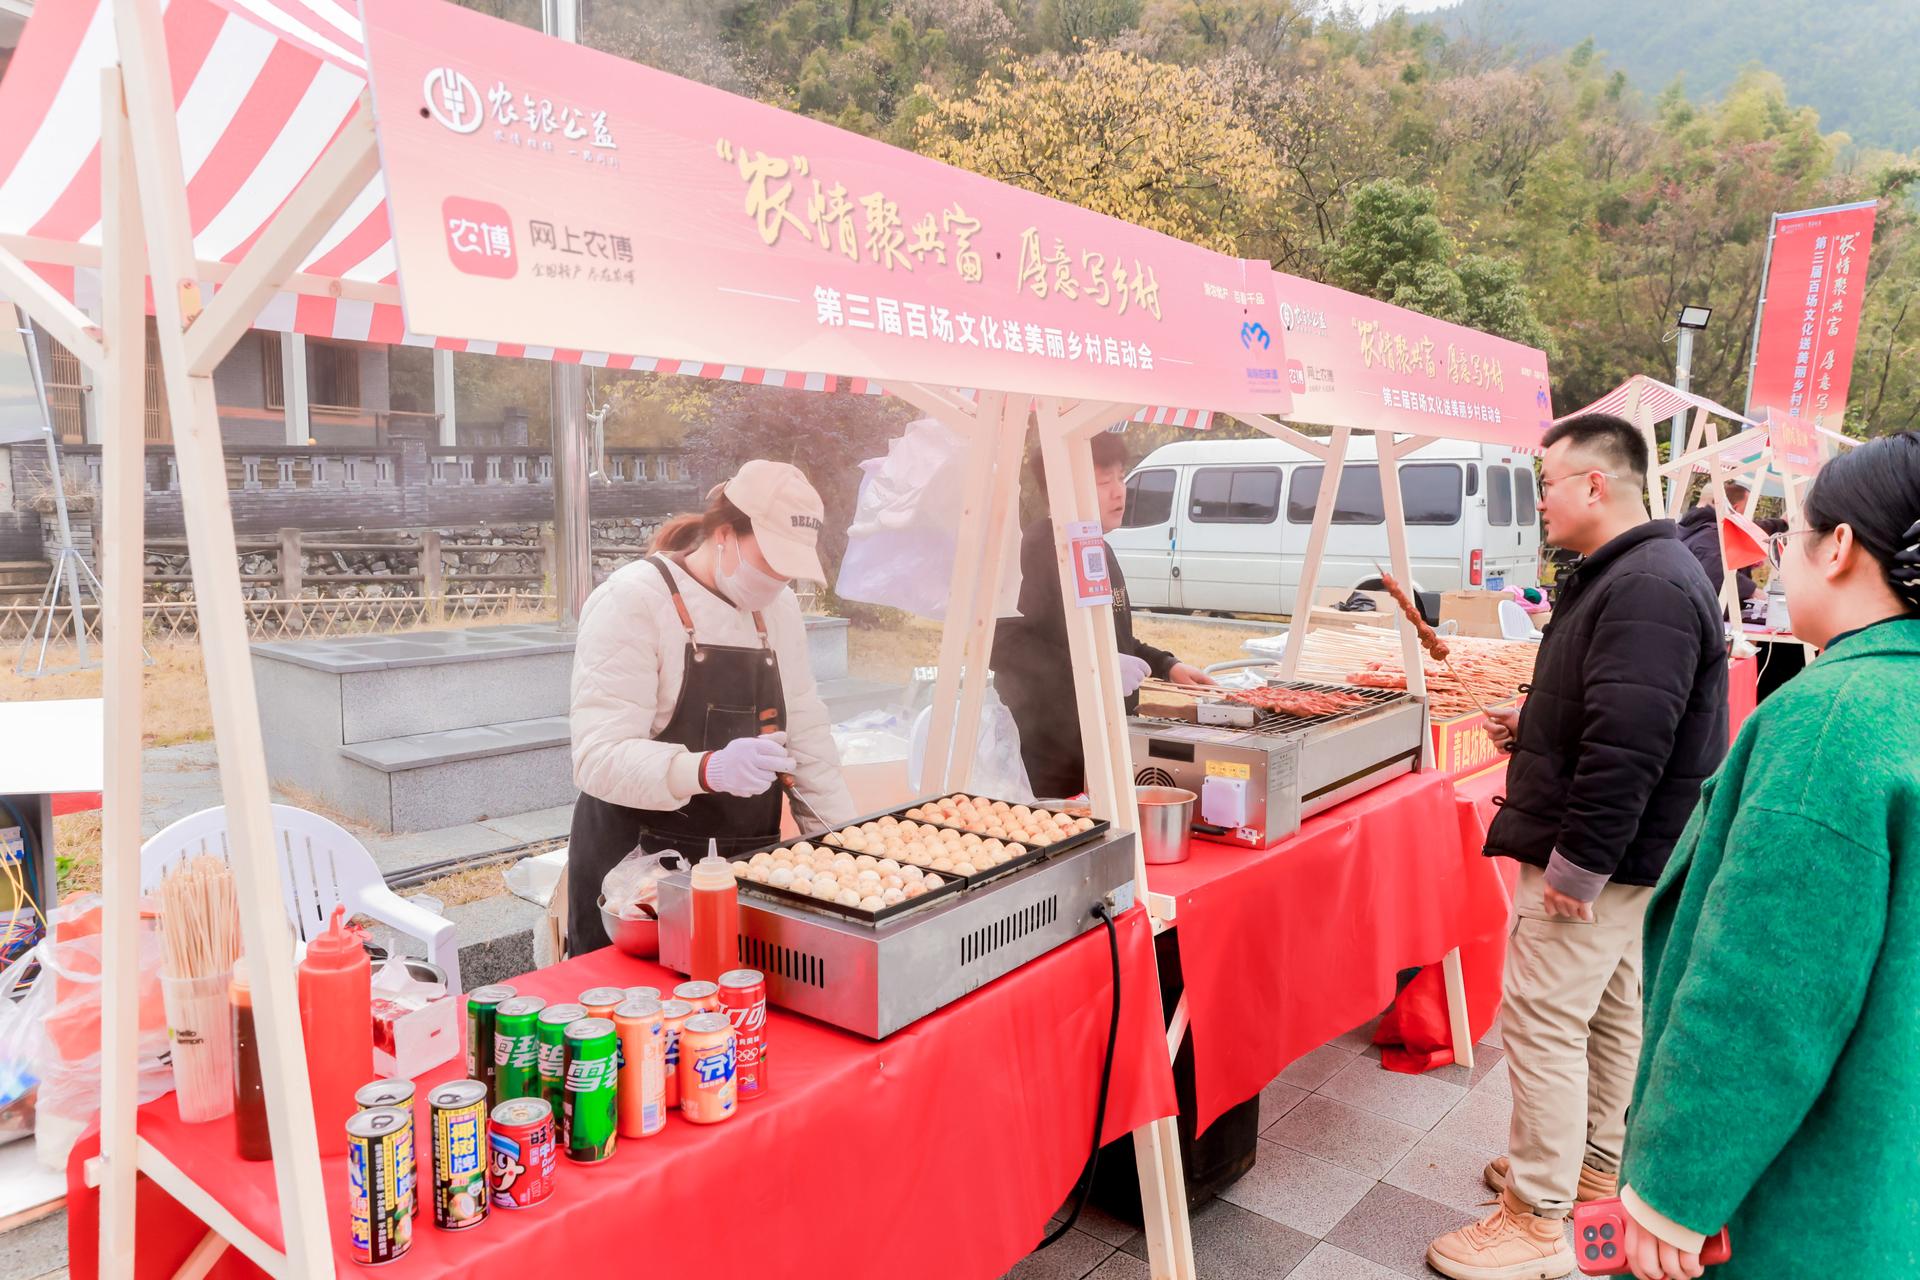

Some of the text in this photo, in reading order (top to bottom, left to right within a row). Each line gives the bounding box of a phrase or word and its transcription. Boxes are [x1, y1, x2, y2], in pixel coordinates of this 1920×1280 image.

[487, 80, 618, 149] 农银公益
[529, 220, 634, 263] 网上农博
[1018, 227, 1163, 321] 厚意写乡村
[813, 284, 1155, 370] 第三届百场文化送美丽乡村启动会
[1382, 387, 1502, 424] 第三届百场文化送美丽乡村启动会
